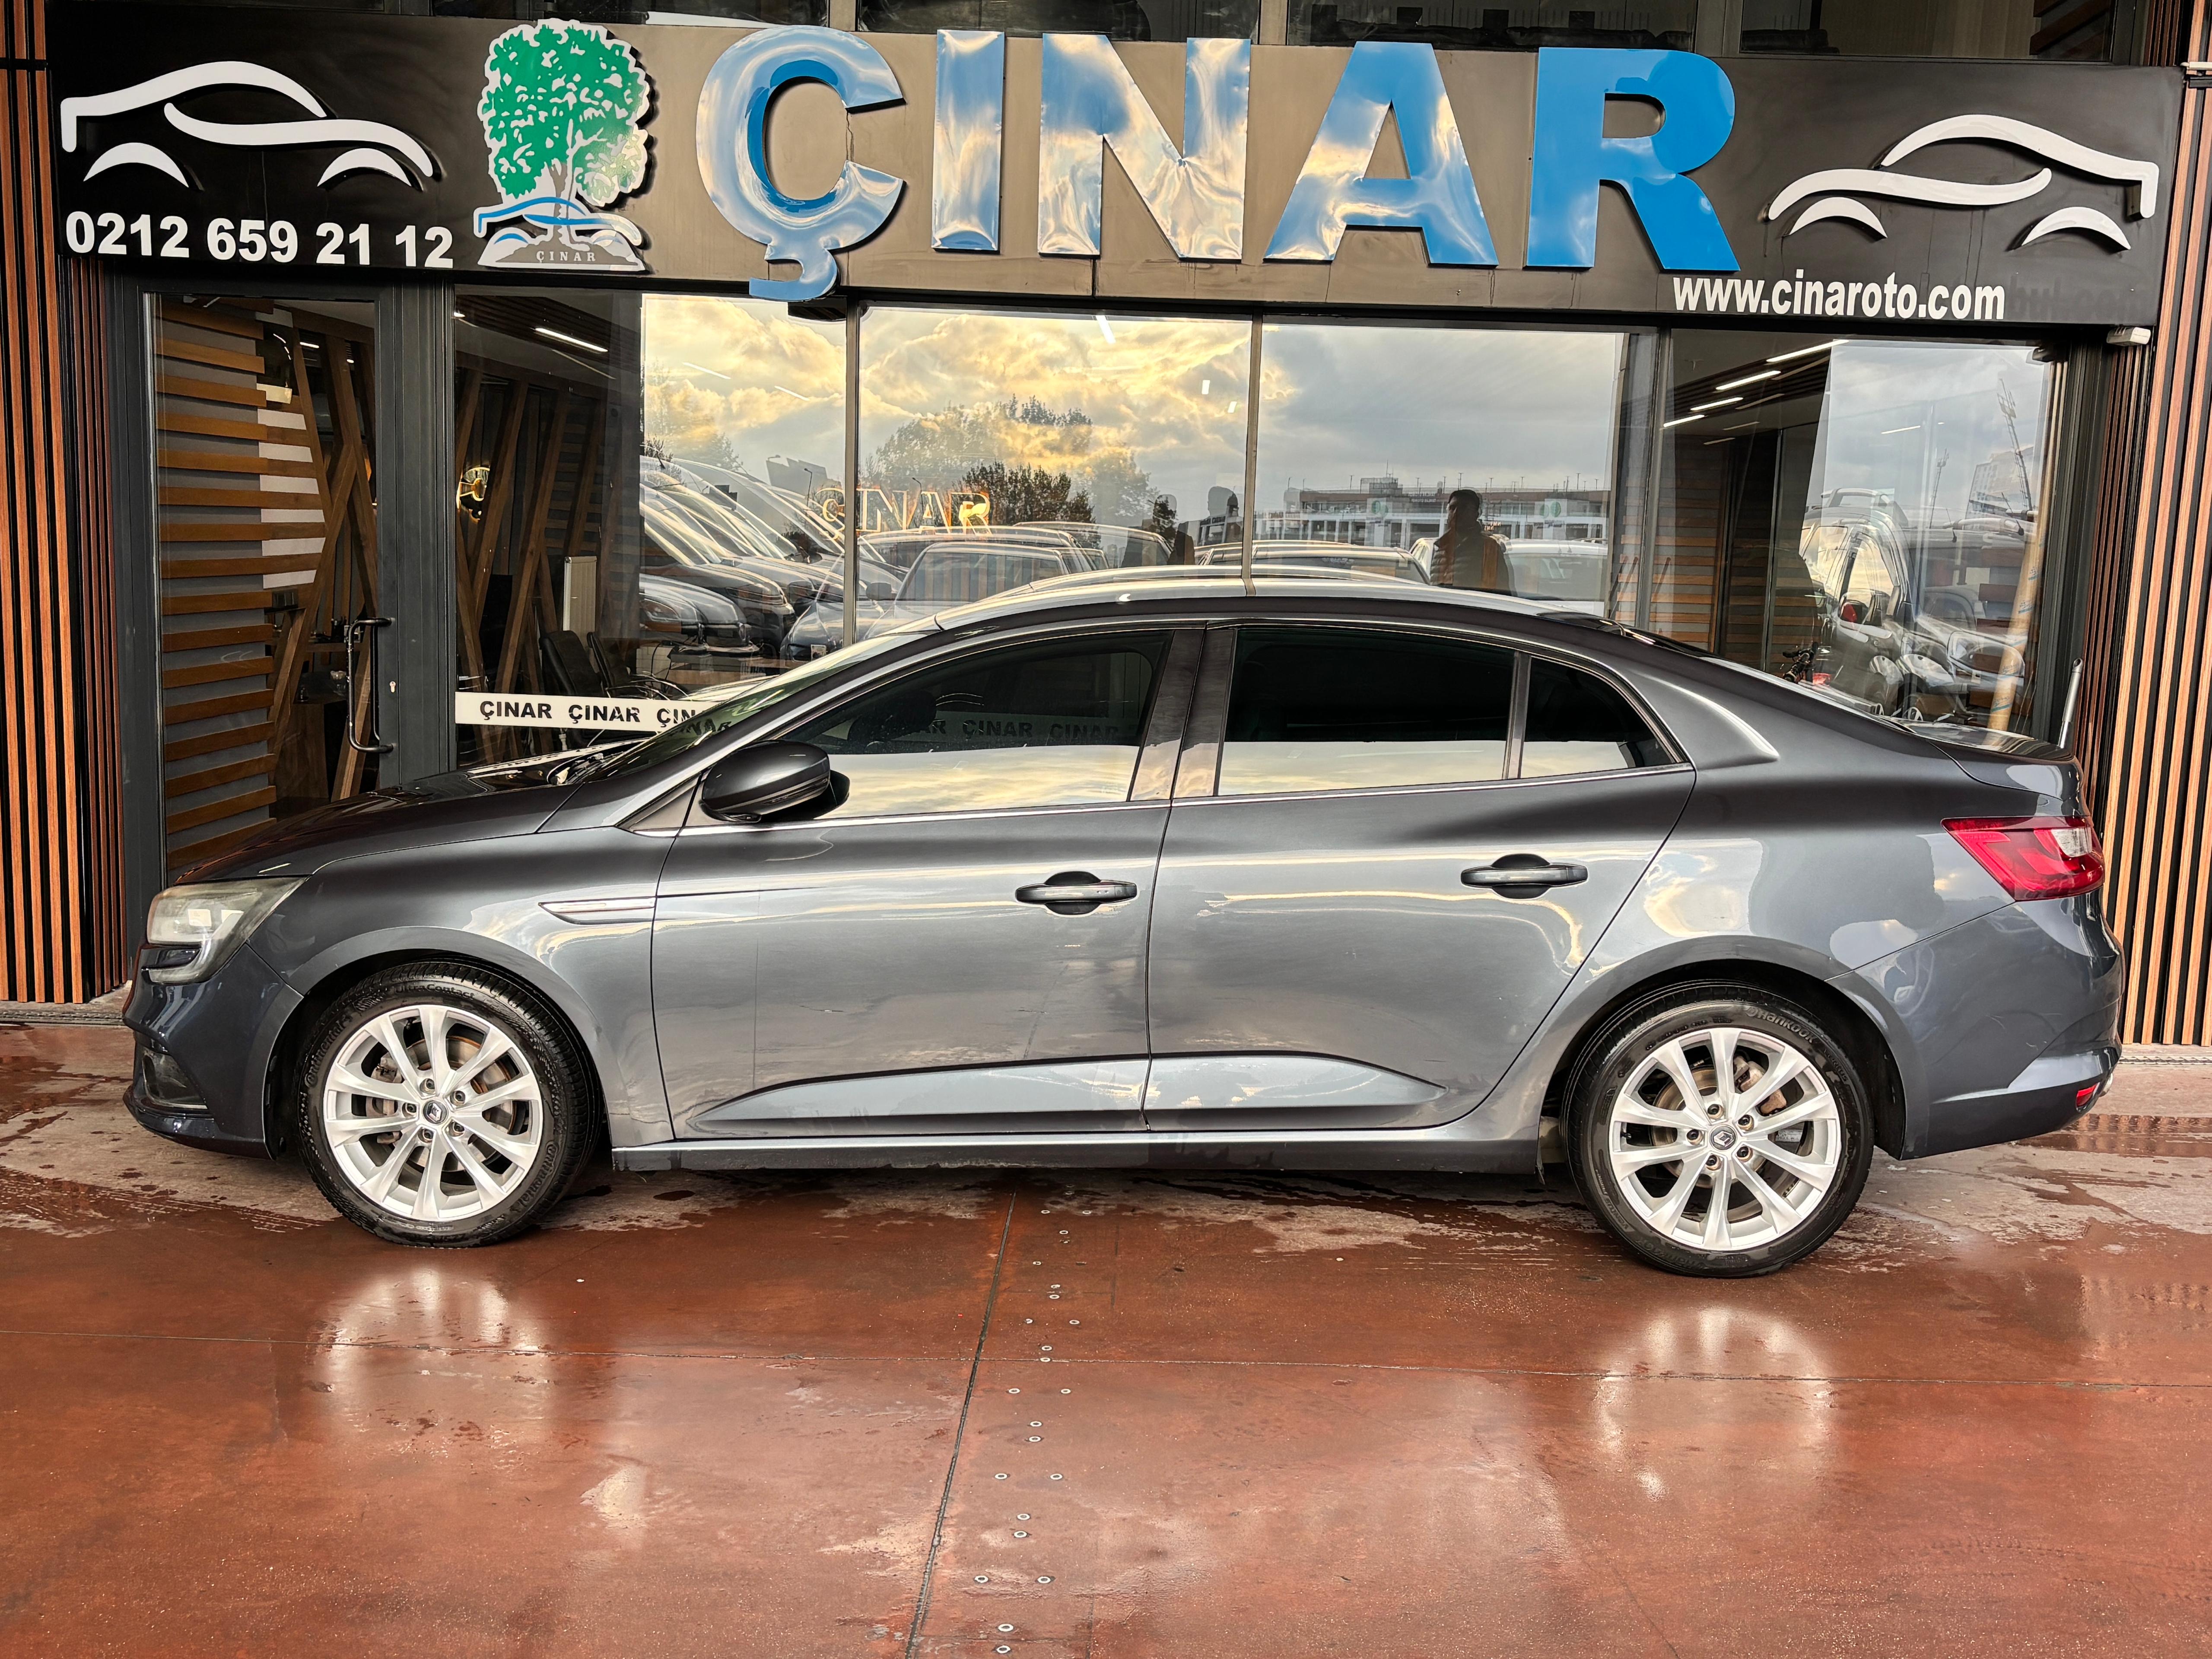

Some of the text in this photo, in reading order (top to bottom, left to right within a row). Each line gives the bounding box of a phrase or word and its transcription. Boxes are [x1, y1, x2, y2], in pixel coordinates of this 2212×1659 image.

[696, 25, 1741, 302] ÇINAR
[66, 211, 453, 269] 0212 659 21 12
[536, 251, 596, 264] ÇINAR
[1673, 269, 2005, 320] www.cinaroto.com
[480, 701, 552, 720] ÇINAR
[569, 705, 640, 724] ÇINAR
